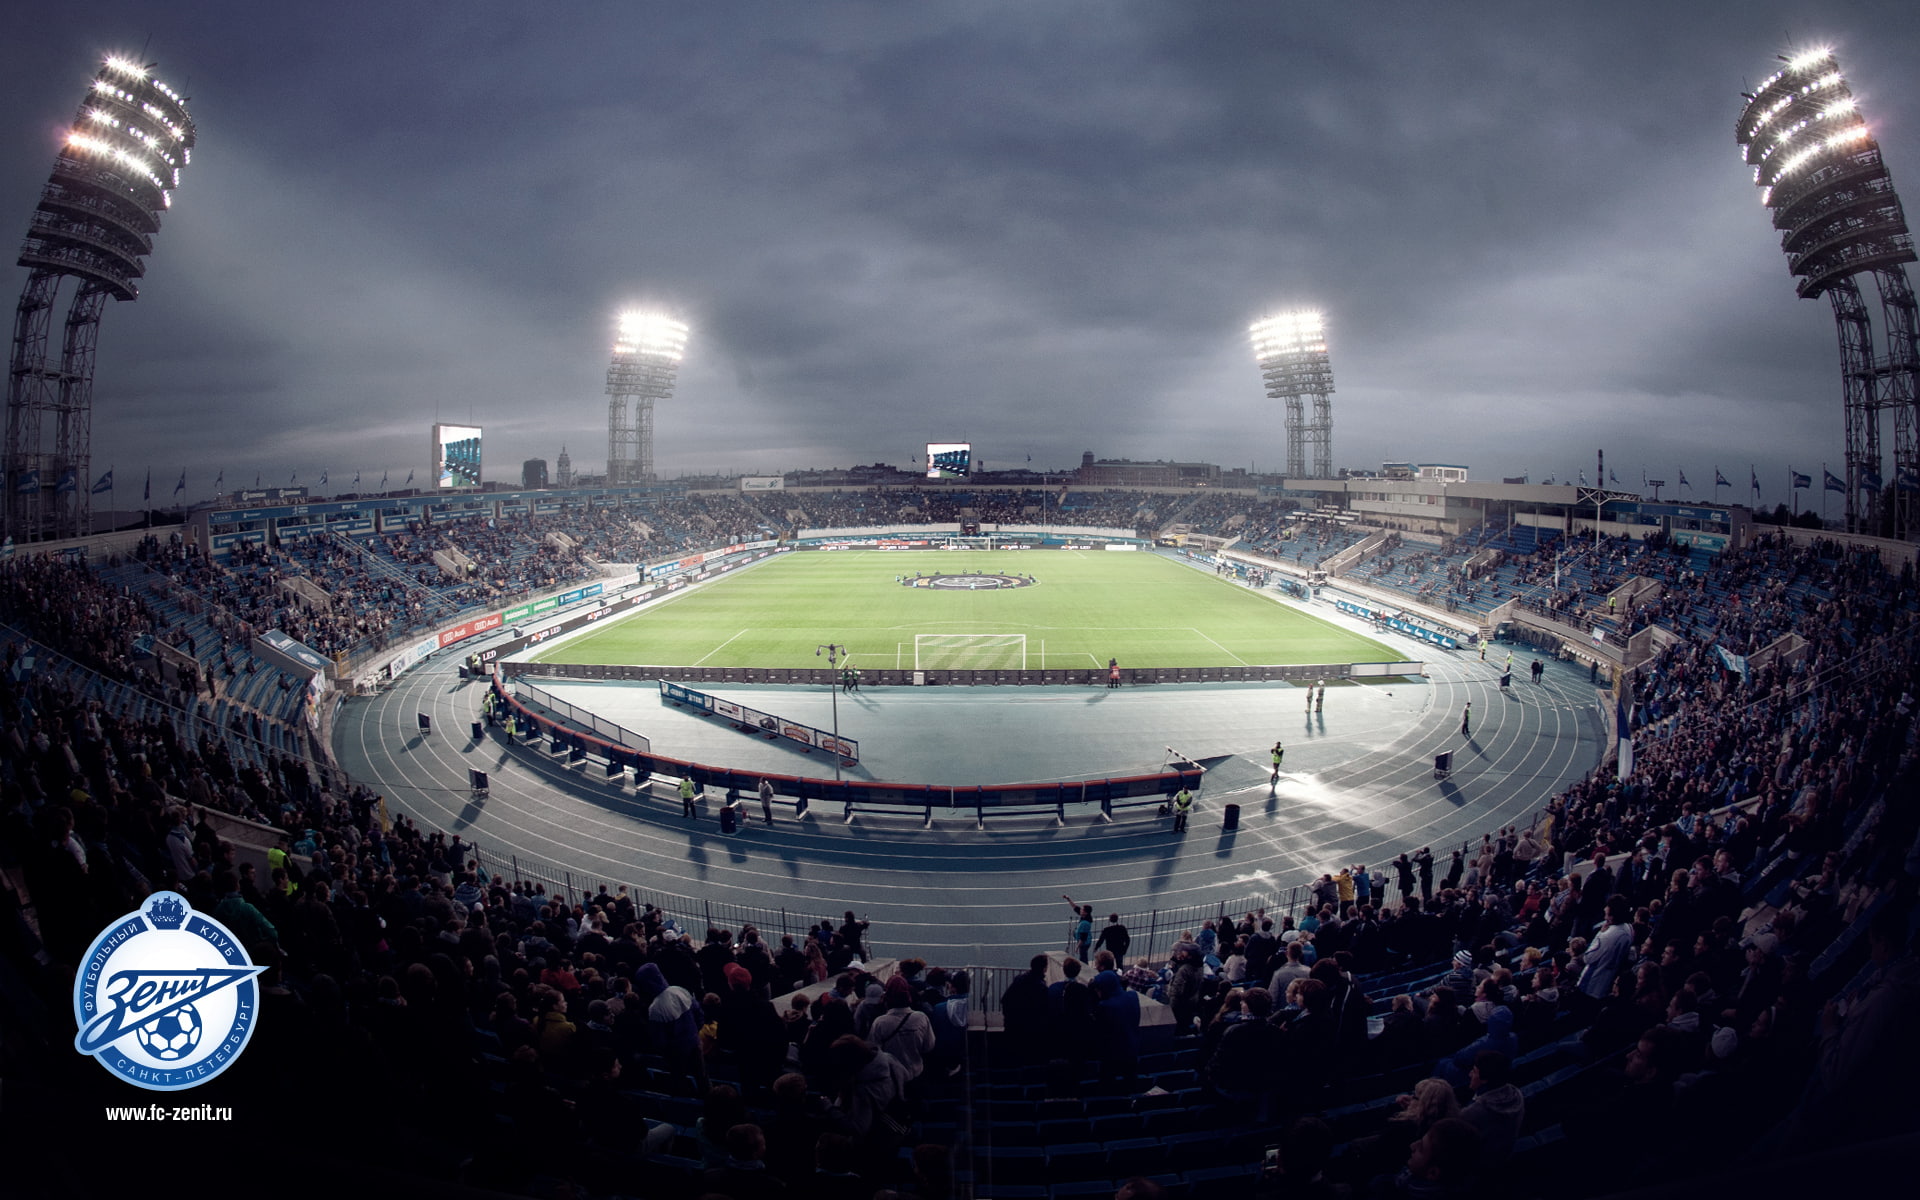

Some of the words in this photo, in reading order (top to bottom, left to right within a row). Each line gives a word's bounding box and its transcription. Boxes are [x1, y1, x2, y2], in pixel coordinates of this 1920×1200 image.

[486, 617, 499, 626] Audi
[454, 627, 466, 637] Audi
[482, 649, 497, 661] LED
